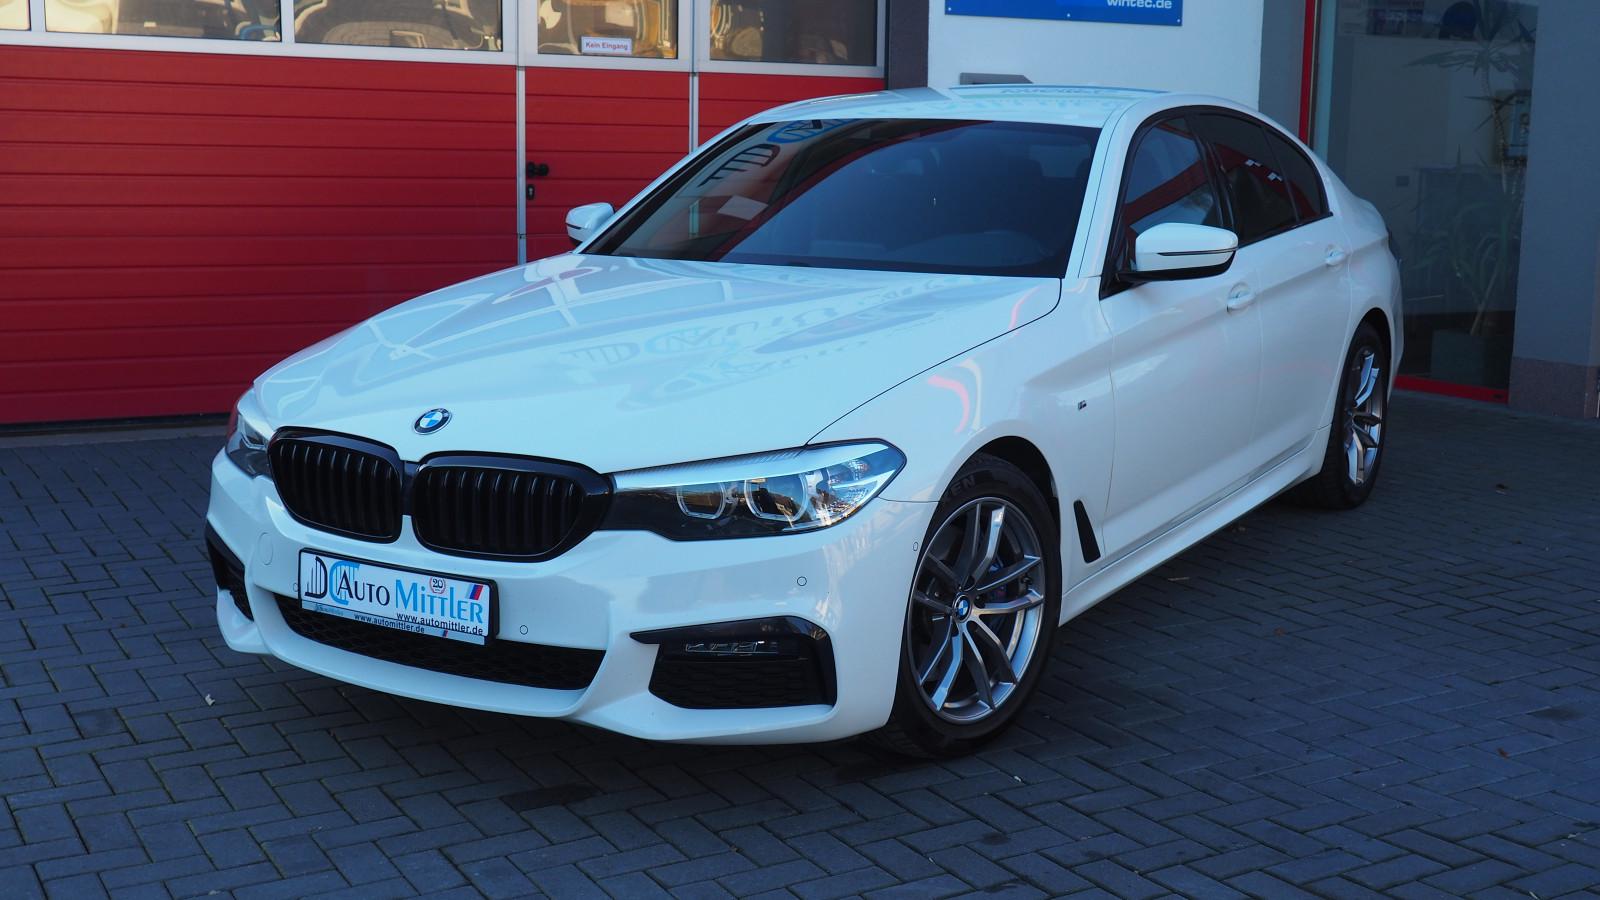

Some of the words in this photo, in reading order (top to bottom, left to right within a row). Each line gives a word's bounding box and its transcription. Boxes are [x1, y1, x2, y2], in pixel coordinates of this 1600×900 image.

[602, 42, 628, 51] Eingang
[432, 578, 444, 589] 20
[353, 613, 425, 634] www.automittler.de
[396, 612, 484, 636] www.automittler.de
